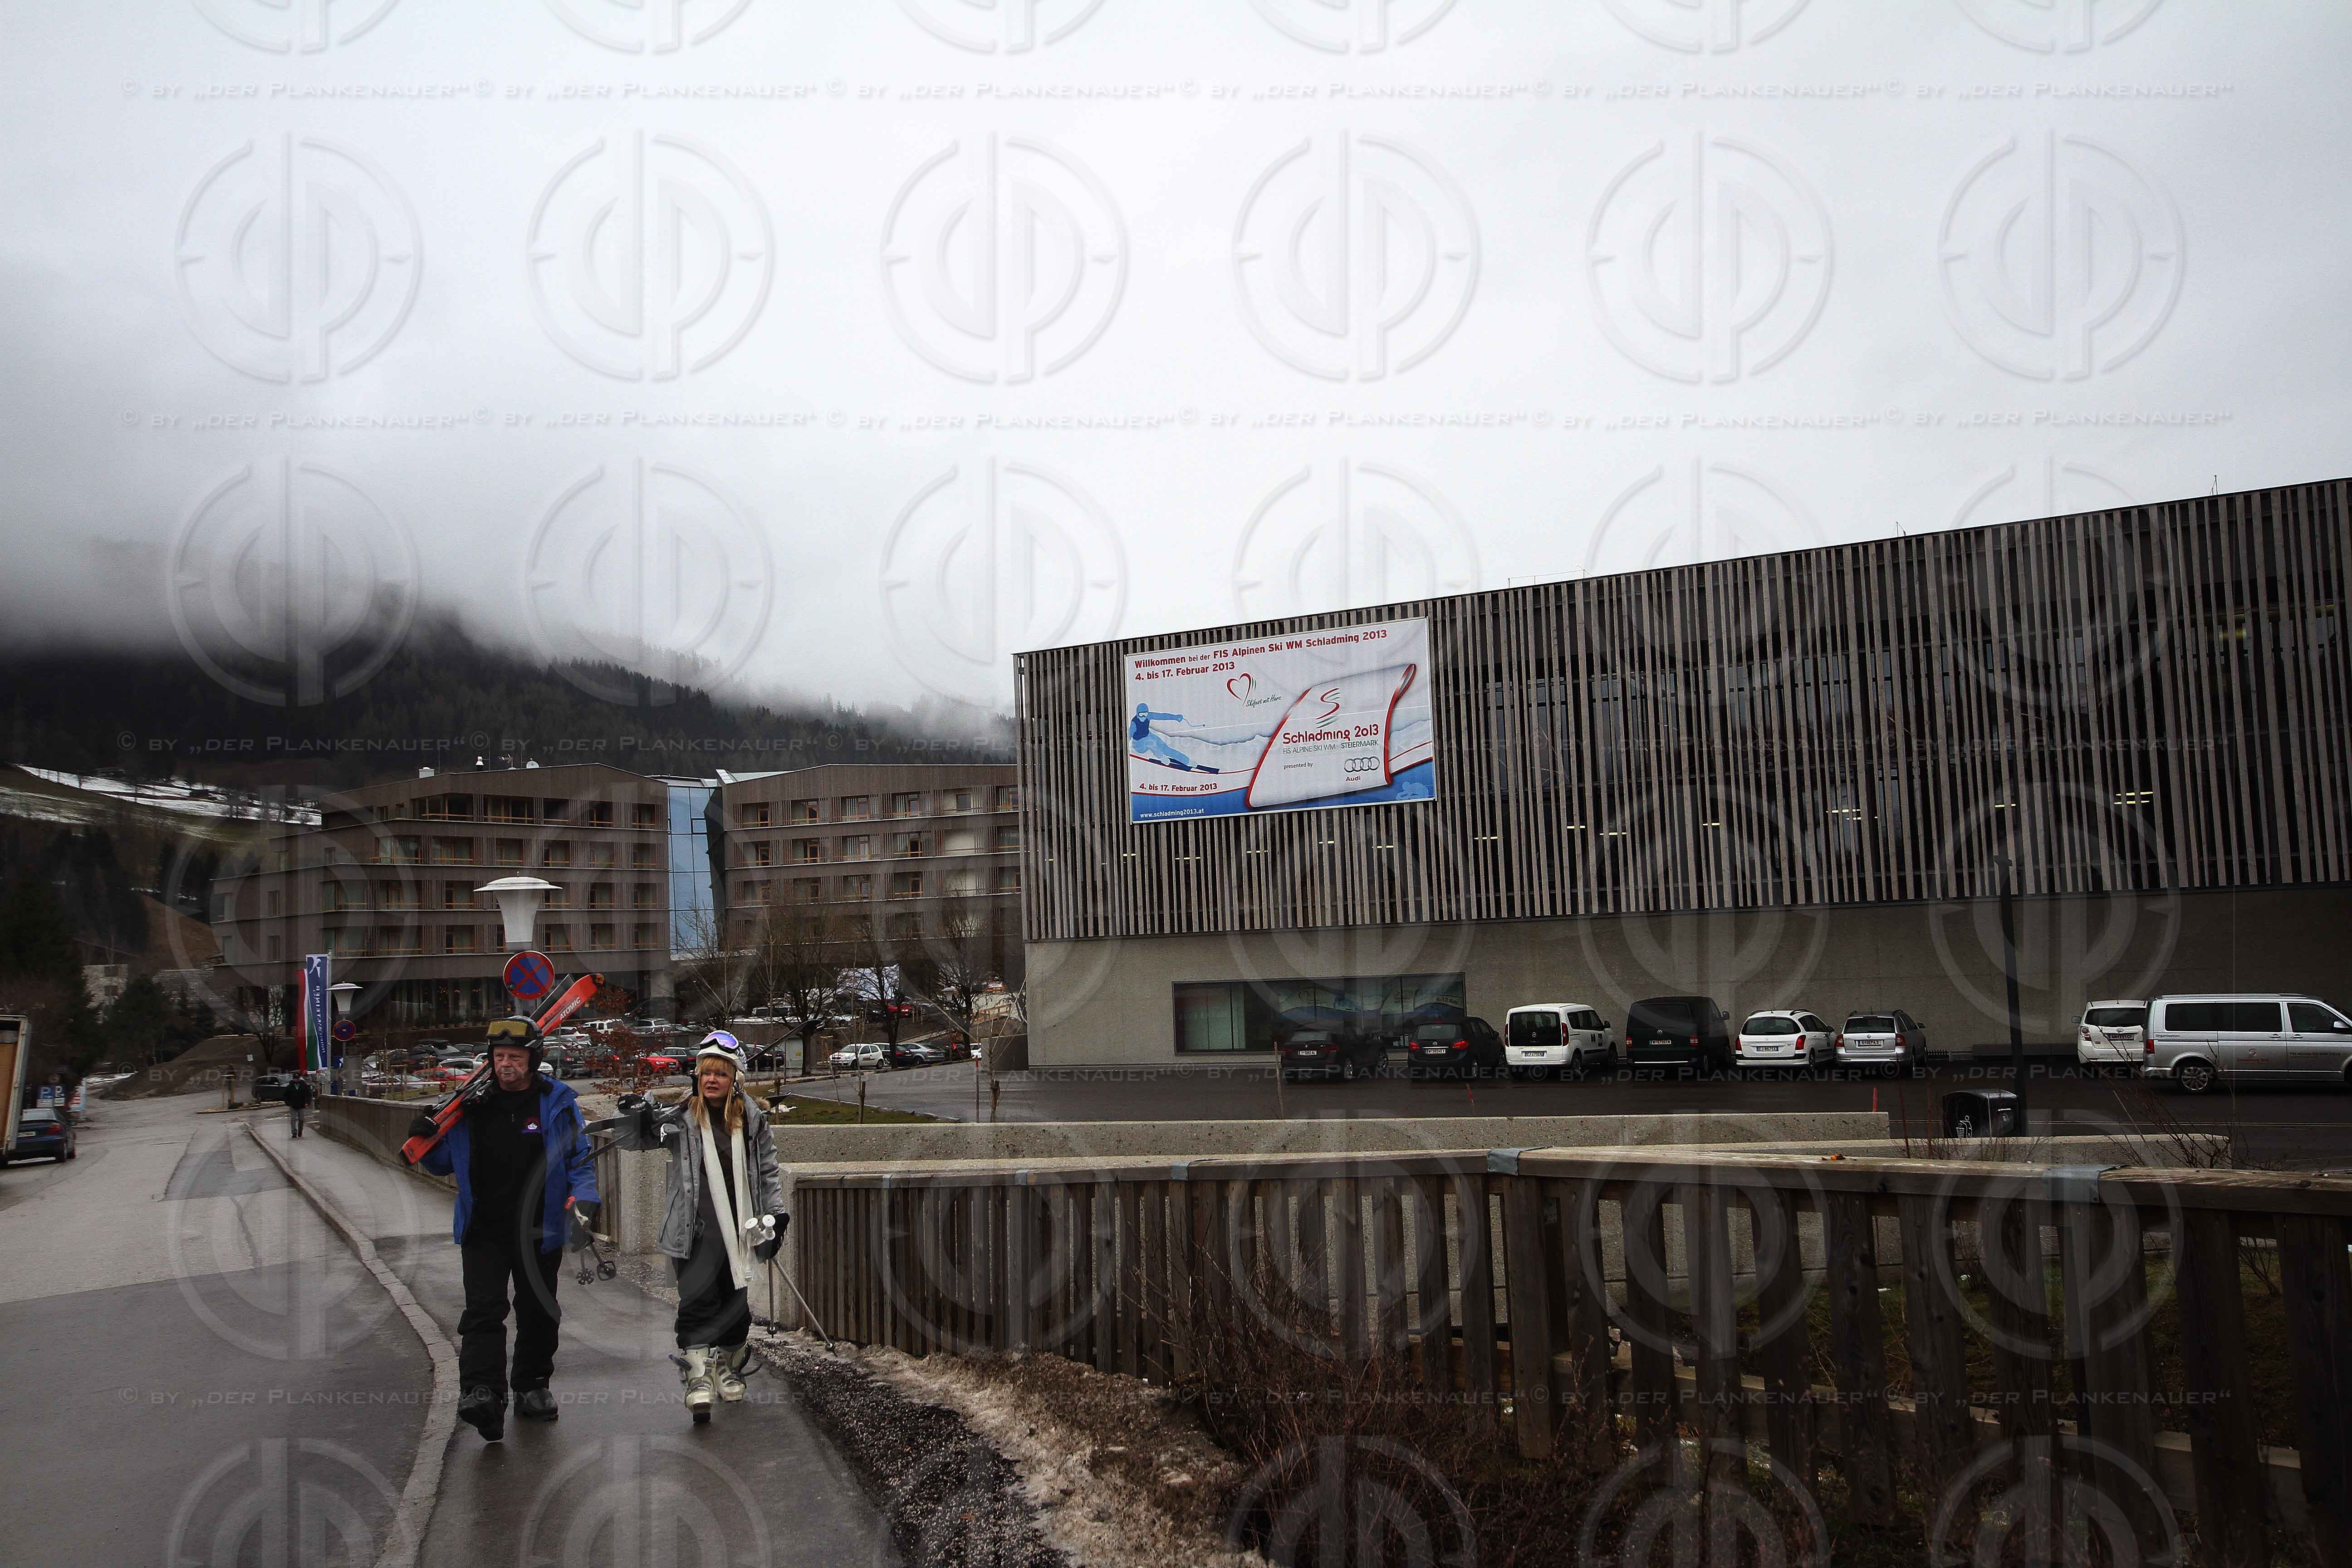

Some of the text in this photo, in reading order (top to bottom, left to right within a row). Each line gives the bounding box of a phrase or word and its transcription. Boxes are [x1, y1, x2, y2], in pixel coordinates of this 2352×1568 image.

[1135, 656, 1186, 668] Willkommen
[1213, 650, 1229, 659] FIS
[1232, 646, 1265, 657] Alpinen
[1269, 642, 1283, 652] Ski
[1286, 640, 1302, 649] WM
[1306, 634, 1359, 647] Schladming
[1362, 629, 1387, 640] 2013
[1147, 671, 1159, 680] bis
[1162, 669, 1173, 677] 17.
[1176, 666, 1209, 676] Februar
[1212, 662, 1235, 671] 2013
[1283, 729, 1350, 744] Schladming
[1341, 739, 1379, 749] STEIERMARK
[1140, 808, 1204, 818] www.schladming2013.at
[560, 997, 581, 1020] ATOMIC
